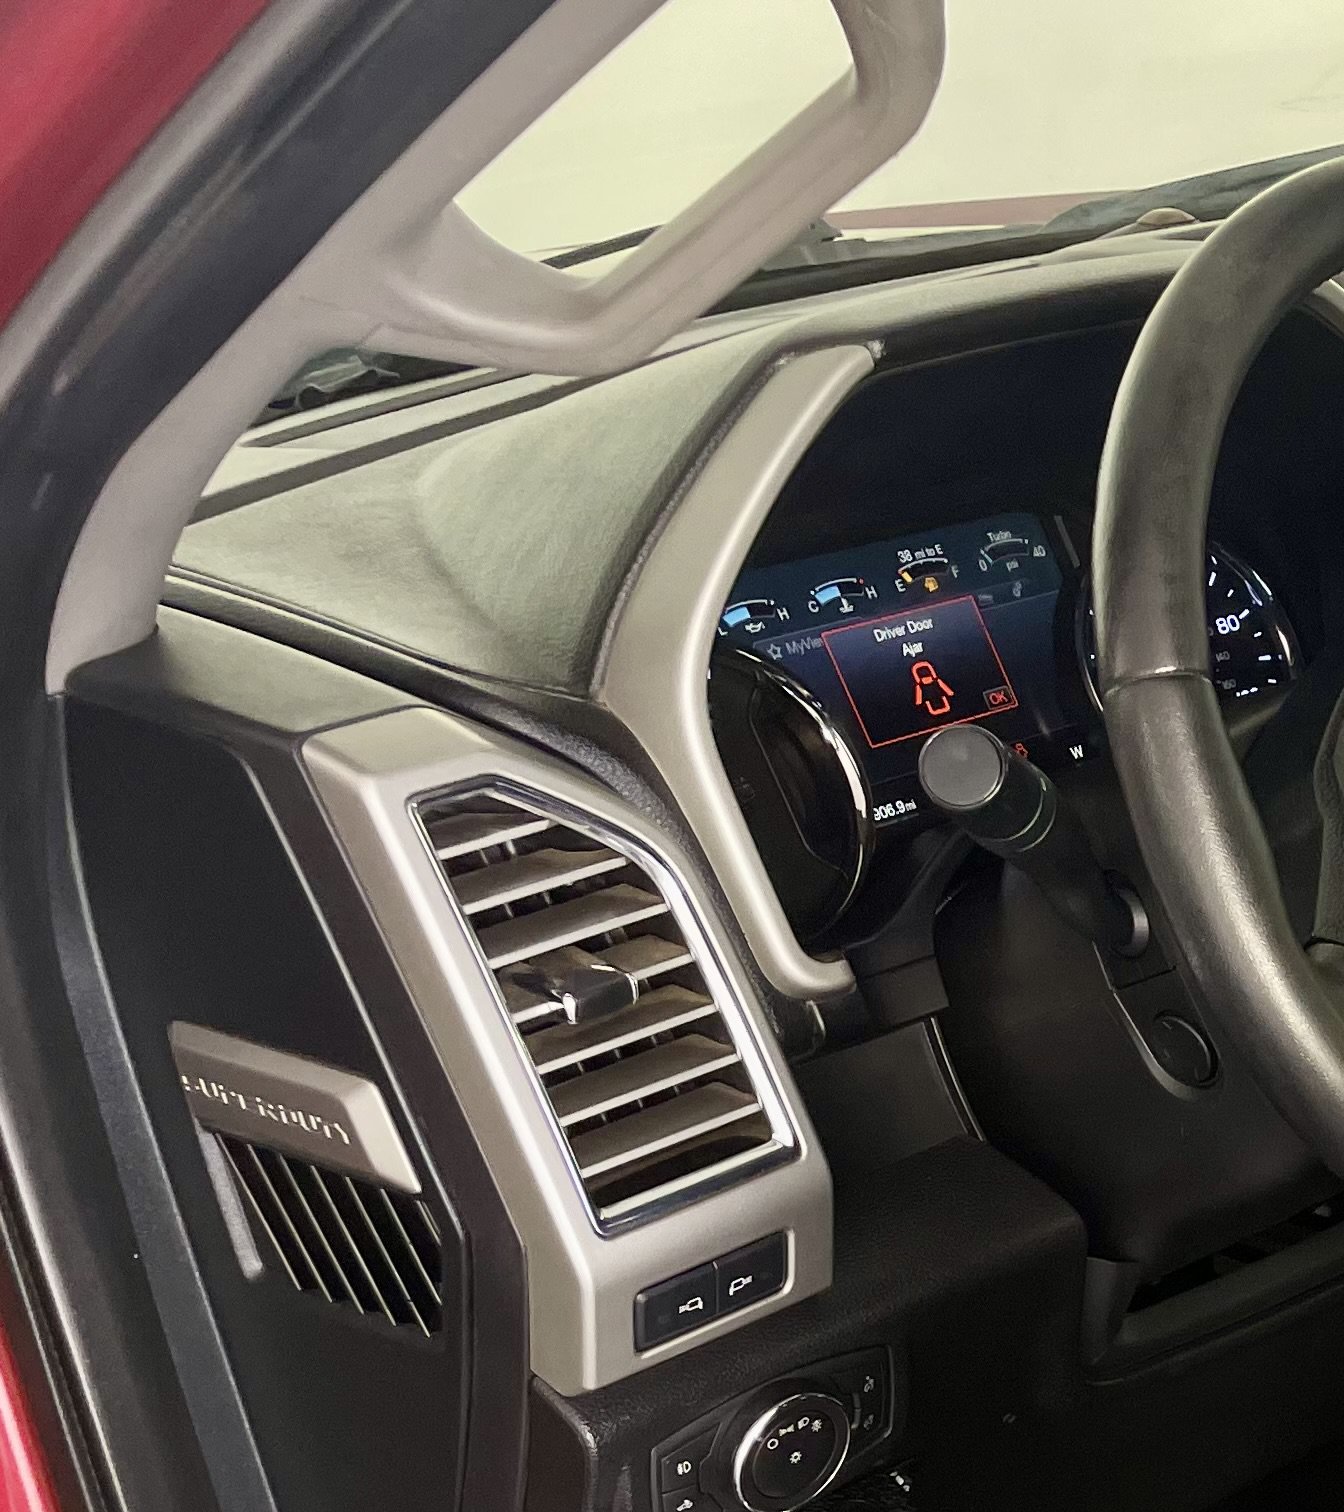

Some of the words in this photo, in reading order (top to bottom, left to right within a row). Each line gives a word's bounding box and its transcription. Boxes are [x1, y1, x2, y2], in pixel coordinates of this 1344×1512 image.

[897, 549, 914, 564] 38
[895, 579, 906, 592] E
[951, 564, 960, 579] F
[808, 601, 819, 613] C
[865, 585, 878, 600] H
[777, 607, 790, 621] H
[873, 624, 906, 643] Driver
[906, 617, 933, 636] Door
[1215, 614, 1240, 635] 80
[902, 641, 923, 658] Ajar
[989, 690, 1008, 706] OK
[1069, 744, 1084, 760] W
